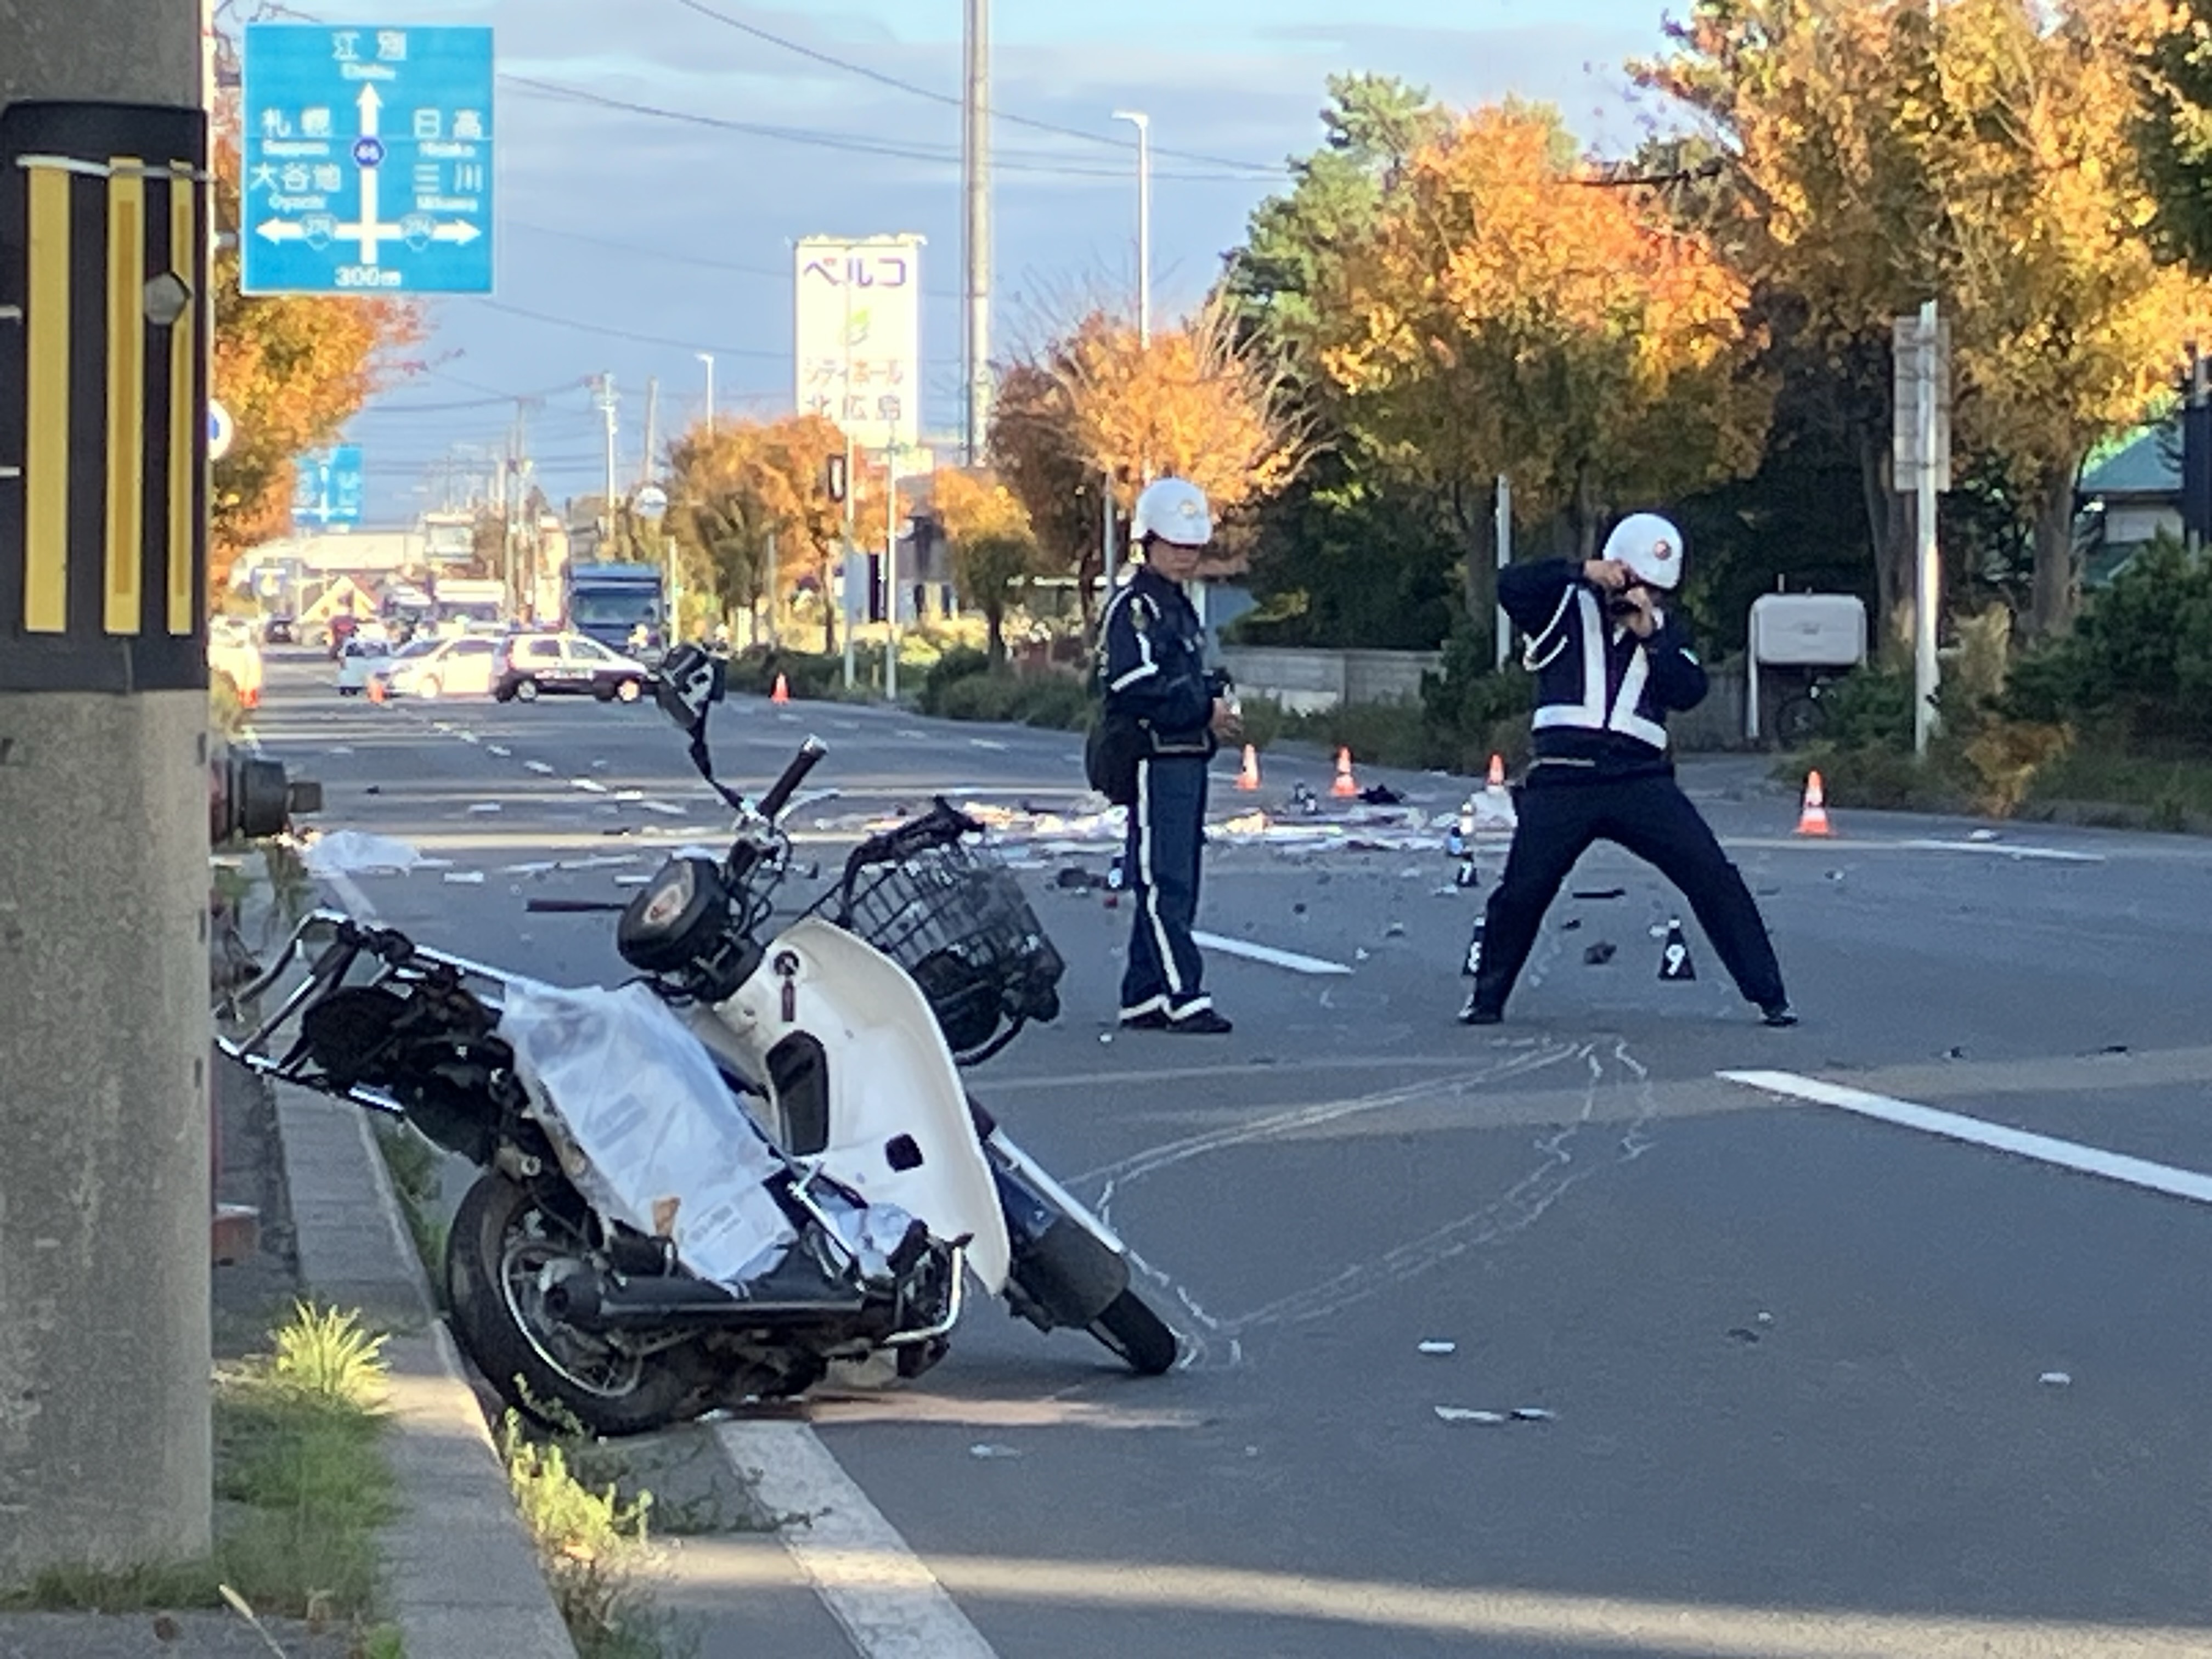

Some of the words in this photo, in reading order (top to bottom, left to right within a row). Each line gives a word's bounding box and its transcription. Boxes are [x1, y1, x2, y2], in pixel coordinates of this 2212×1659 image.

[414, 163, 483, 193] 三川
[335, 266, 402, 286] 300m
[804, 257, 907, 289] ベルコ
[1666, 944, 1685, 976] 9
